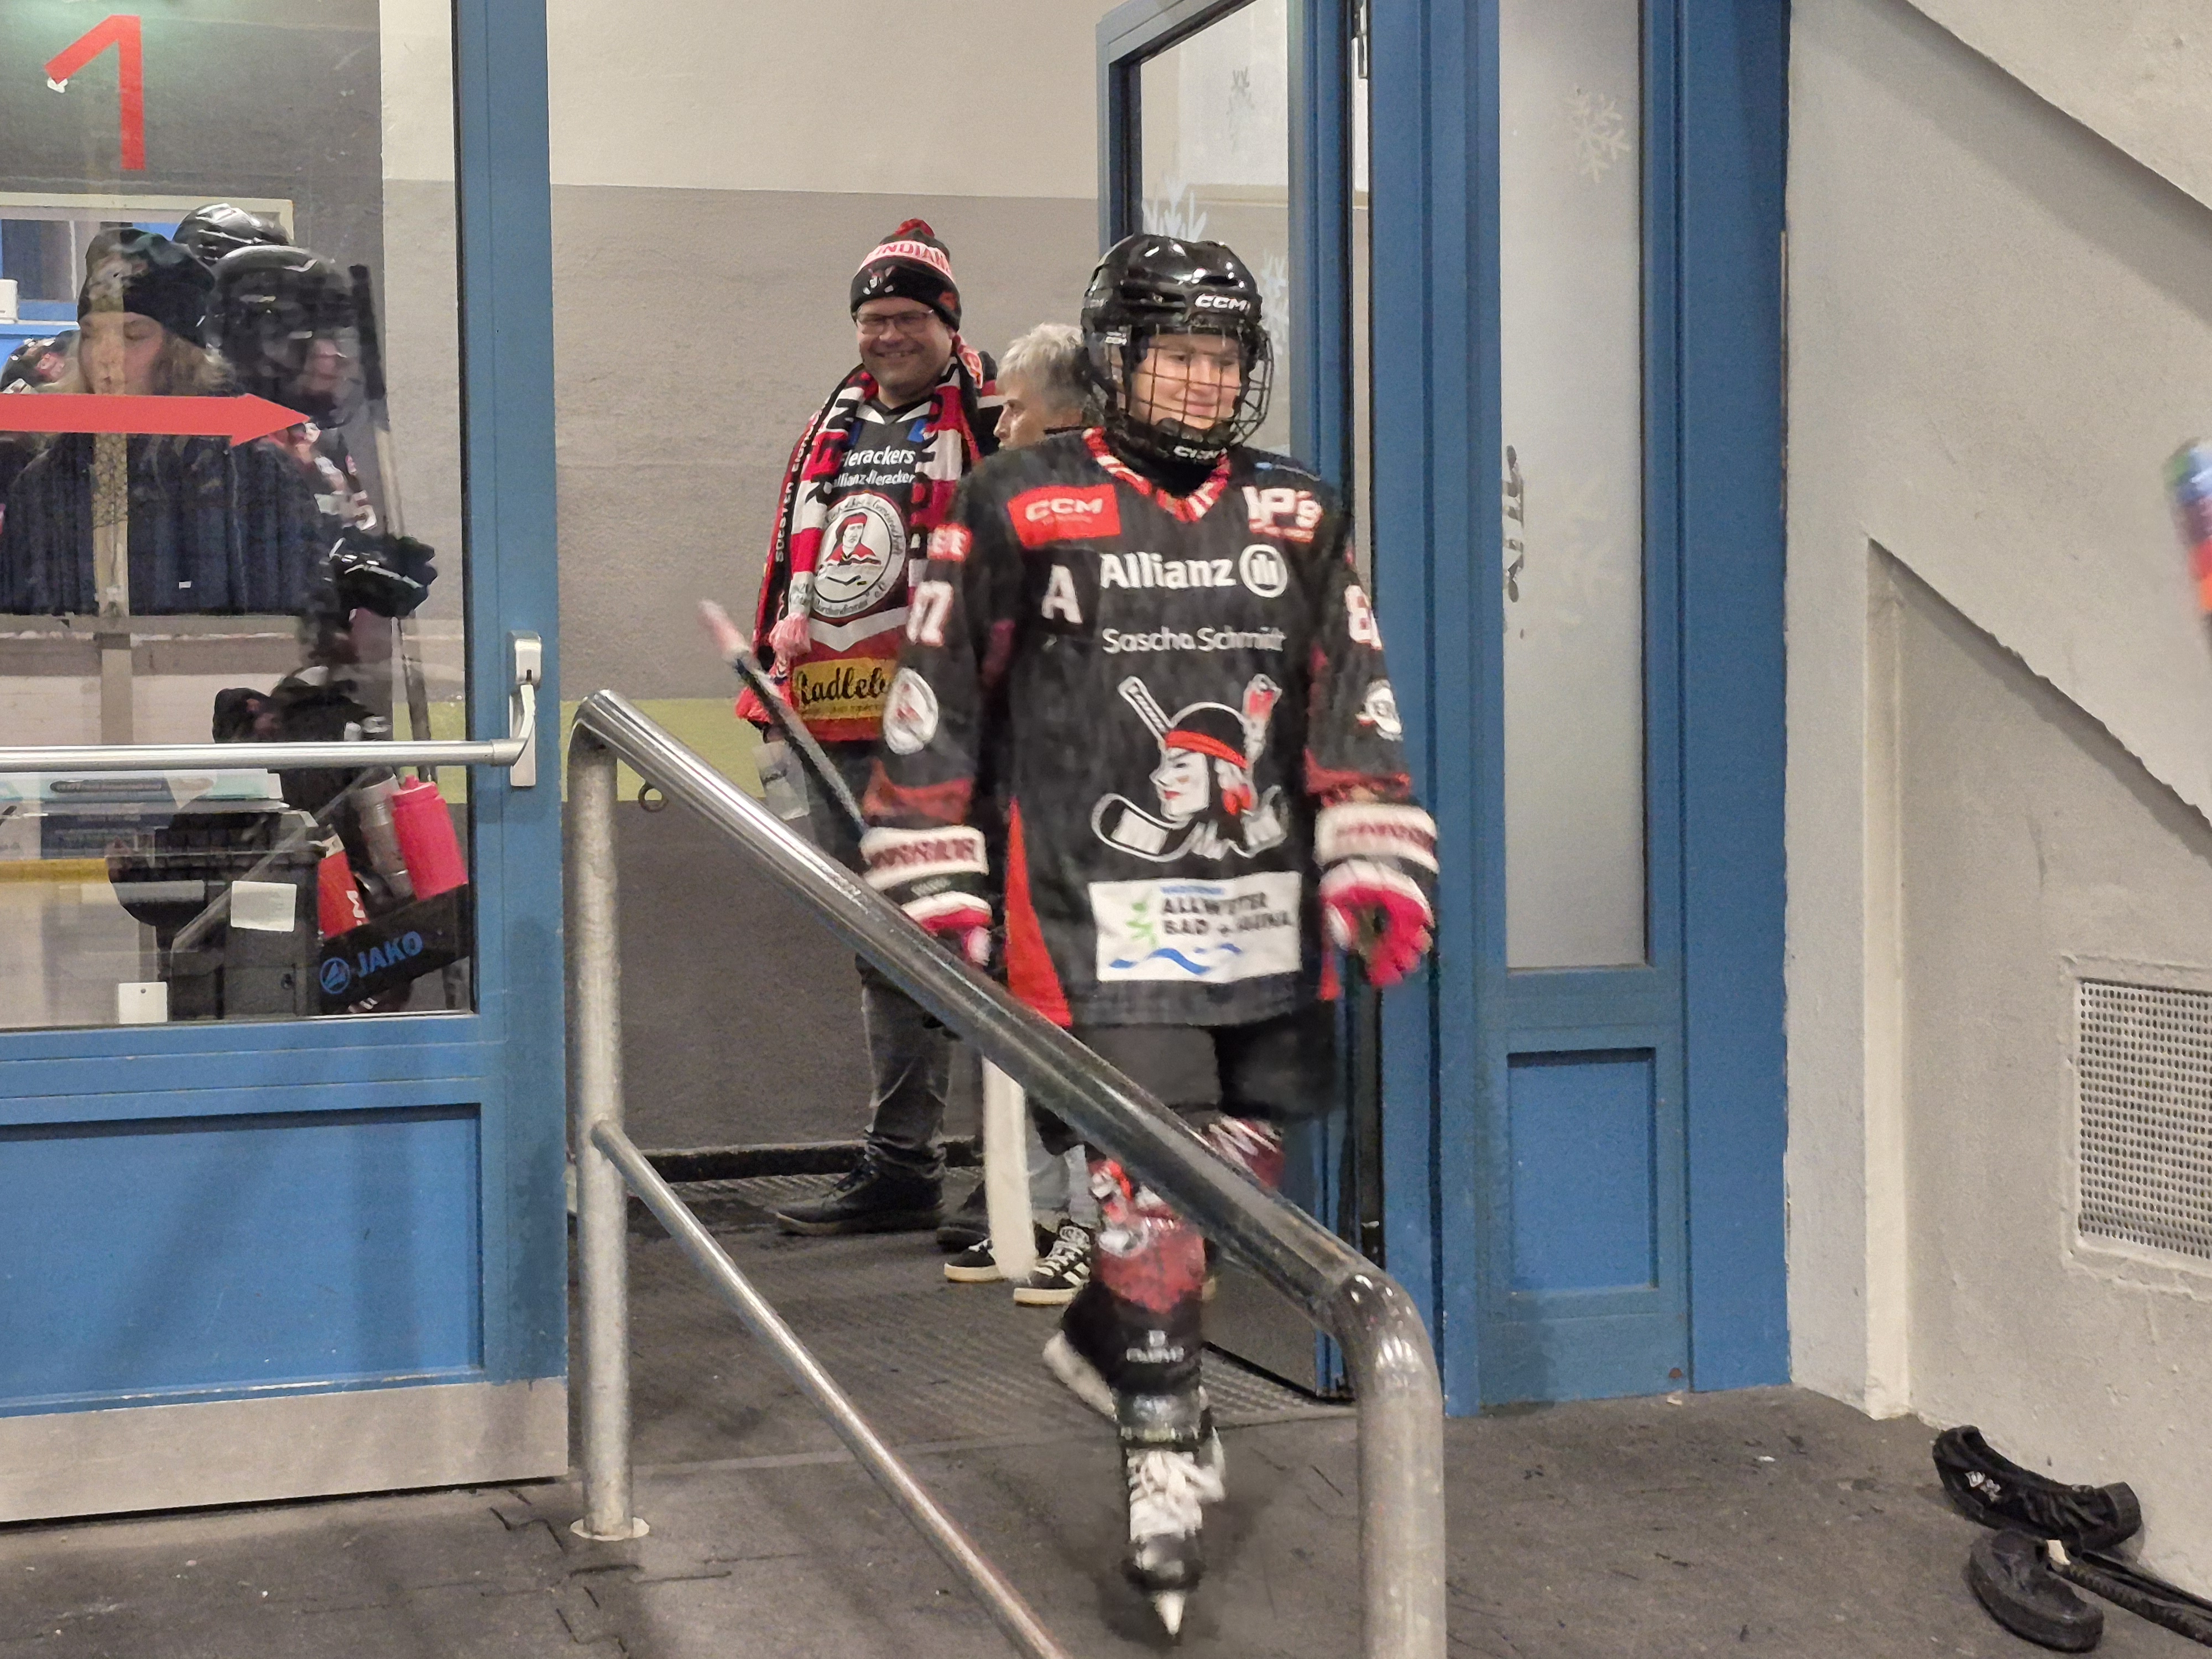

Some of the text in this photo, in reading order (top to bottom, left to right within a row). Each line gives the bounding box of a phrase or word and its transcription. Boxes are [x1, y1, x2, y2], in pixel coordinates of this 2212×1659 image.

[1194, 293, 1251, 312] CCM
[1025, 498, 1103, 523] CCM
[1100, 551, 1237, 589] Allianz
[1042, 565, 1083, 624] A
[357, 931, 424, 978] JAKO
